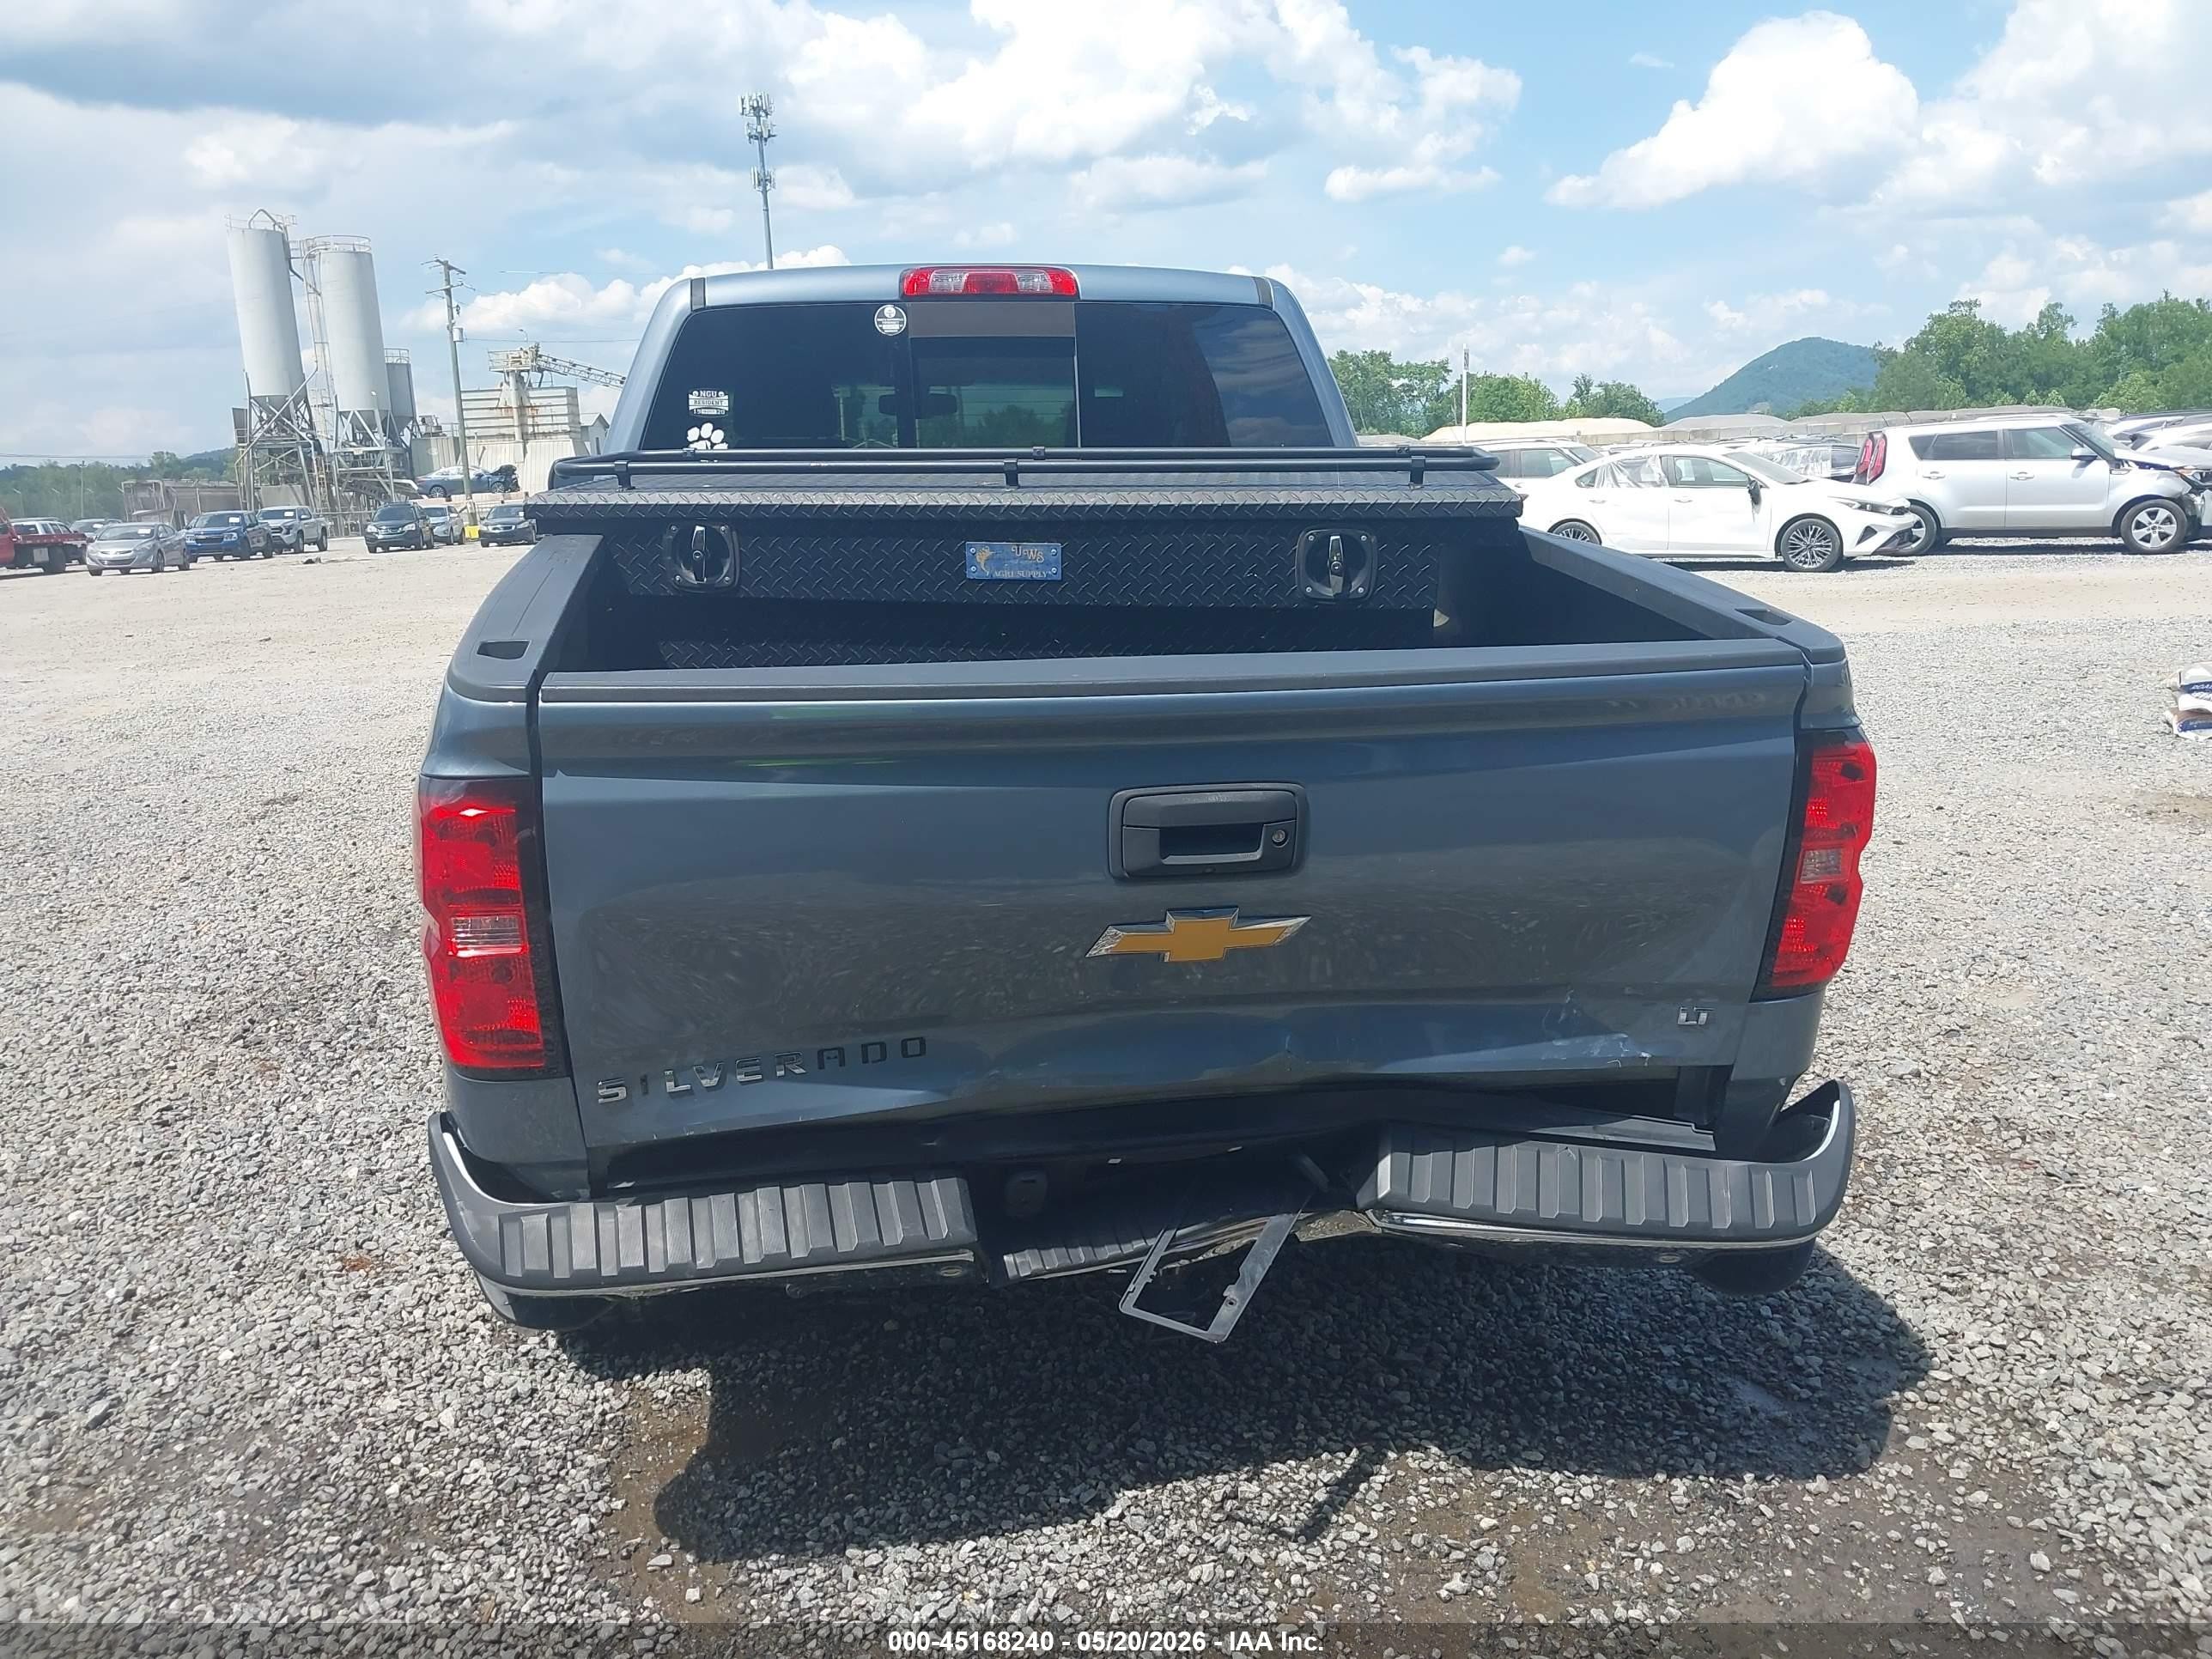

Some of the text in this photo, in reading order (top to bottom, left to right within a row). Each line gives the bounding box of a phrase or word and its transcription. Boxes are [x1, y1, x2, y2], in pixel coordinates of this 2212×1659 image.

[1011, 544, 1045, 563] UWS
[1677, 1006, 1716, 1025] LT
[598, 1036, 927, 1103] SILVERADO
